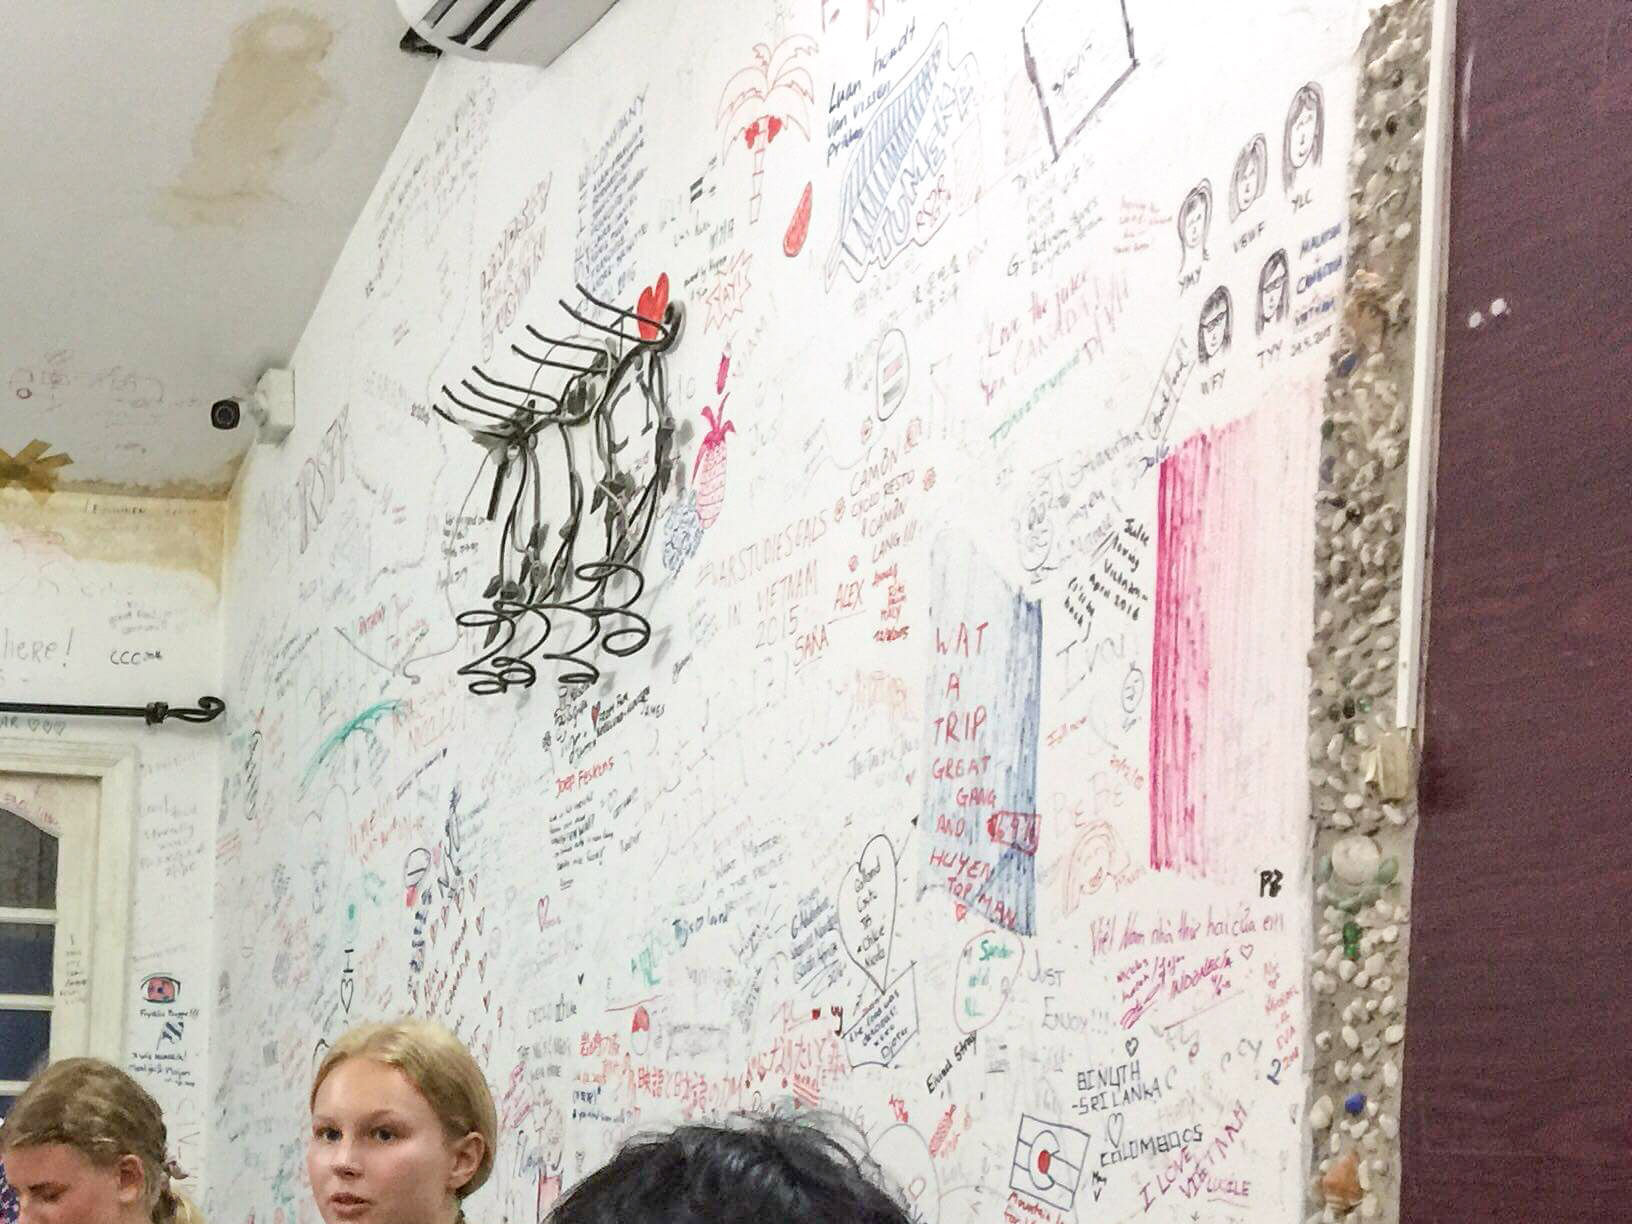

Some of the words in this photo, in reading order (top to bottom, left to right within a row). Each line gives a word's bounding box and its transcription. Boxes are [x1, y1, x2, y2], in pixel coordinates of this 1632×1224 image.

[936, 622, 990, 658] WAT
[945, 672, 961, 701] A
[933, 704, 988, 746] TRIP
[932, 754, 992, 782] GREAT
[956, 787, 997, 809] GANG
[930, 846, 993, 882] HUYEN
[947, 876, 970, 901] TOP
[978, 893, 1018, 931] MAN
[1155, 1145, 1192, 1195] LOVE
